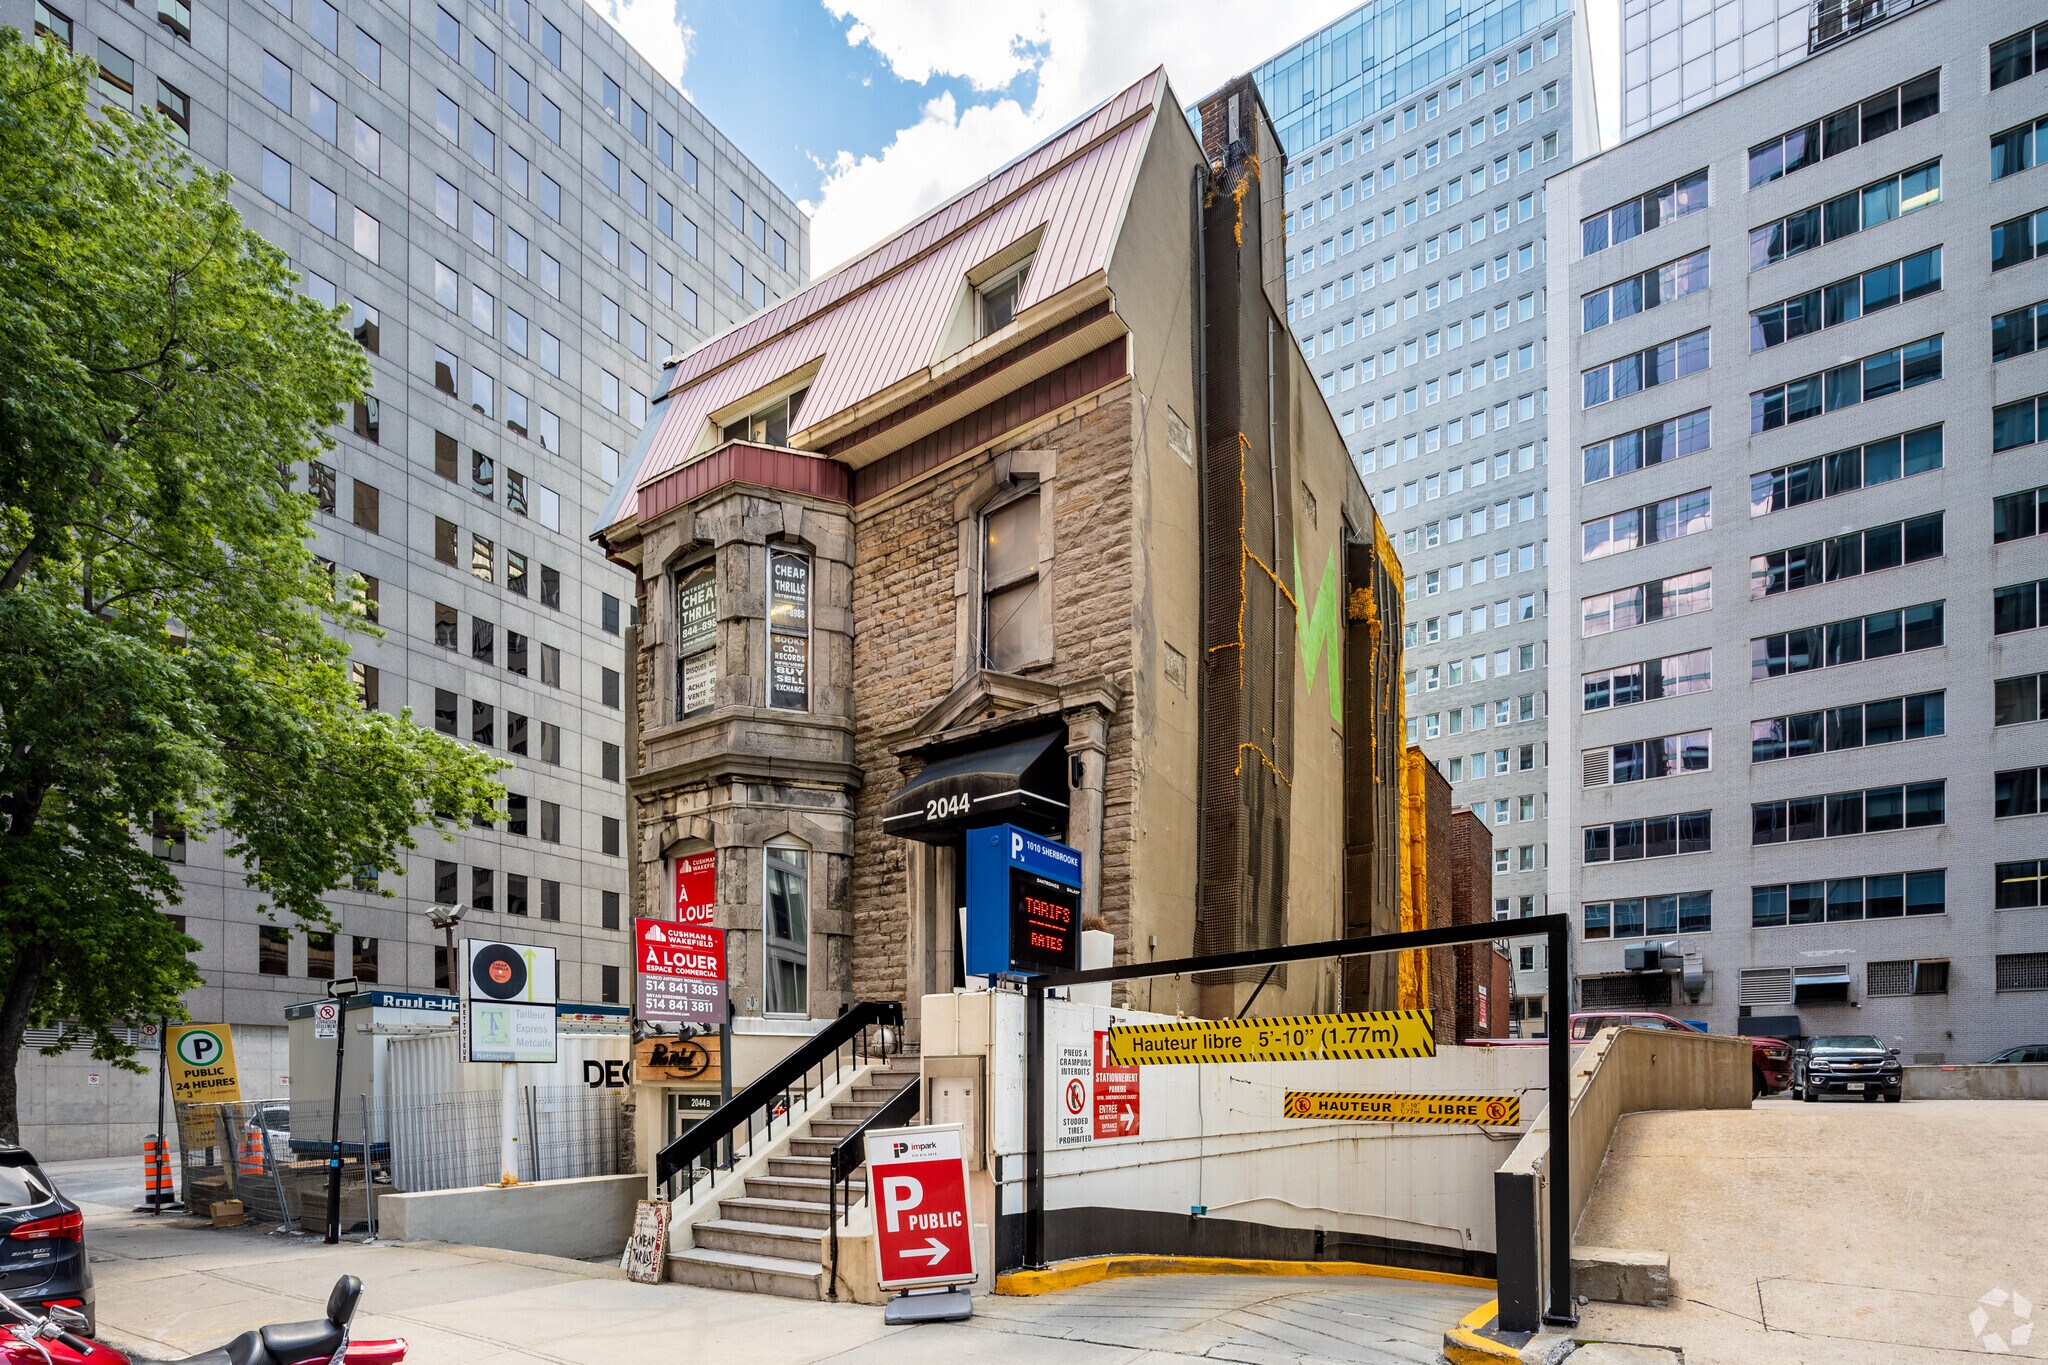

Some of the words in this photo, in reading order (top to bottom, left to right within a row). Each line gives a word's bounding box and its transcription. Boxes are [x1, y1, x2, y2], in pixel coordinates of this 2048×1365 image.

[775, 565, 805, 579] CHEAP
[775, 580, 805, 594] THRILLS
[775, 593, 805, 601] ENTERPRISES
[775, 637, 804, 645] BOOKS
[775, 652, 805, 662] RECORDS
[686, 663, 706, 674] DISQUES
[927, 793, 970, 820] 2044
[1012, 832, 1023, 859] P
[1027, 841, 1040, 853] 1010
[1042, 846, 1078, 867] SHERBROOKE
[679, 884, 688, 902] À
[680, 904, 713, 922] LOUE
[1026, 897, 1070, 923] TARIFS
[668, 930, 706, 940] CUSHMAN
[669, 937, 713, 948] WAKEFIELD
[1031, 933, 1063, 951] RATES
[646, 946, 659, 964] À
[664, 951, 717, 970] LOUER
[646, 965, 672, 973] ESPACE
[676, 968, 718, 977] COMMERCIAL
[646, 980, 665, 991] 514
[669, 983, 688, 994] 841
[691, 984, 718, 996] 3805
[646, 998, 665, 1009] 514
[669, 1000, 688, 1010] 841
[691, 1002, 713, 1012] 3811
[516, 1010, 545, 1019] Tailleur
[516, 1024, 548, 1034] Express
[516, 1038, 552, 1048] Metcalfe
[1133, 1036, 1198, 1052] Hauteur
[1203, 1033, 1242, 1050] libre
[1321, 1025, 1399, 1048] (1.77m)
[193, 1038, 213, 1060] P
[1064, 1049, 1082, 1057] PNEUS
[477, 1052, 511, 1060] Nettoyeur
[1060, 1058, 1091, 1066] CRAMPONS
[184, 1067, 224, 1078] PUBLIC
[1096, 1073, 1138, 1082] STATIONNEMENT
[176, 1082, 190, 1090] 24
[193, 1078, 235, 1089] HEURES
[1099, 1101, 1118, 1114] ENTRÉE
[1318, 1101, 1392, 1113] HAUTEUR
[1428, 1104, 1478, 1115] LIBRE
[1063, 1117, 1088, 1126] STUDDED
[1059, 1135, 1092, 1144] PROHIBITED
[912, 1142, 936, 1151] impark
[882, 1176, 923, 1232] P
[909, 1211, 962, 1231] PUBLIC
